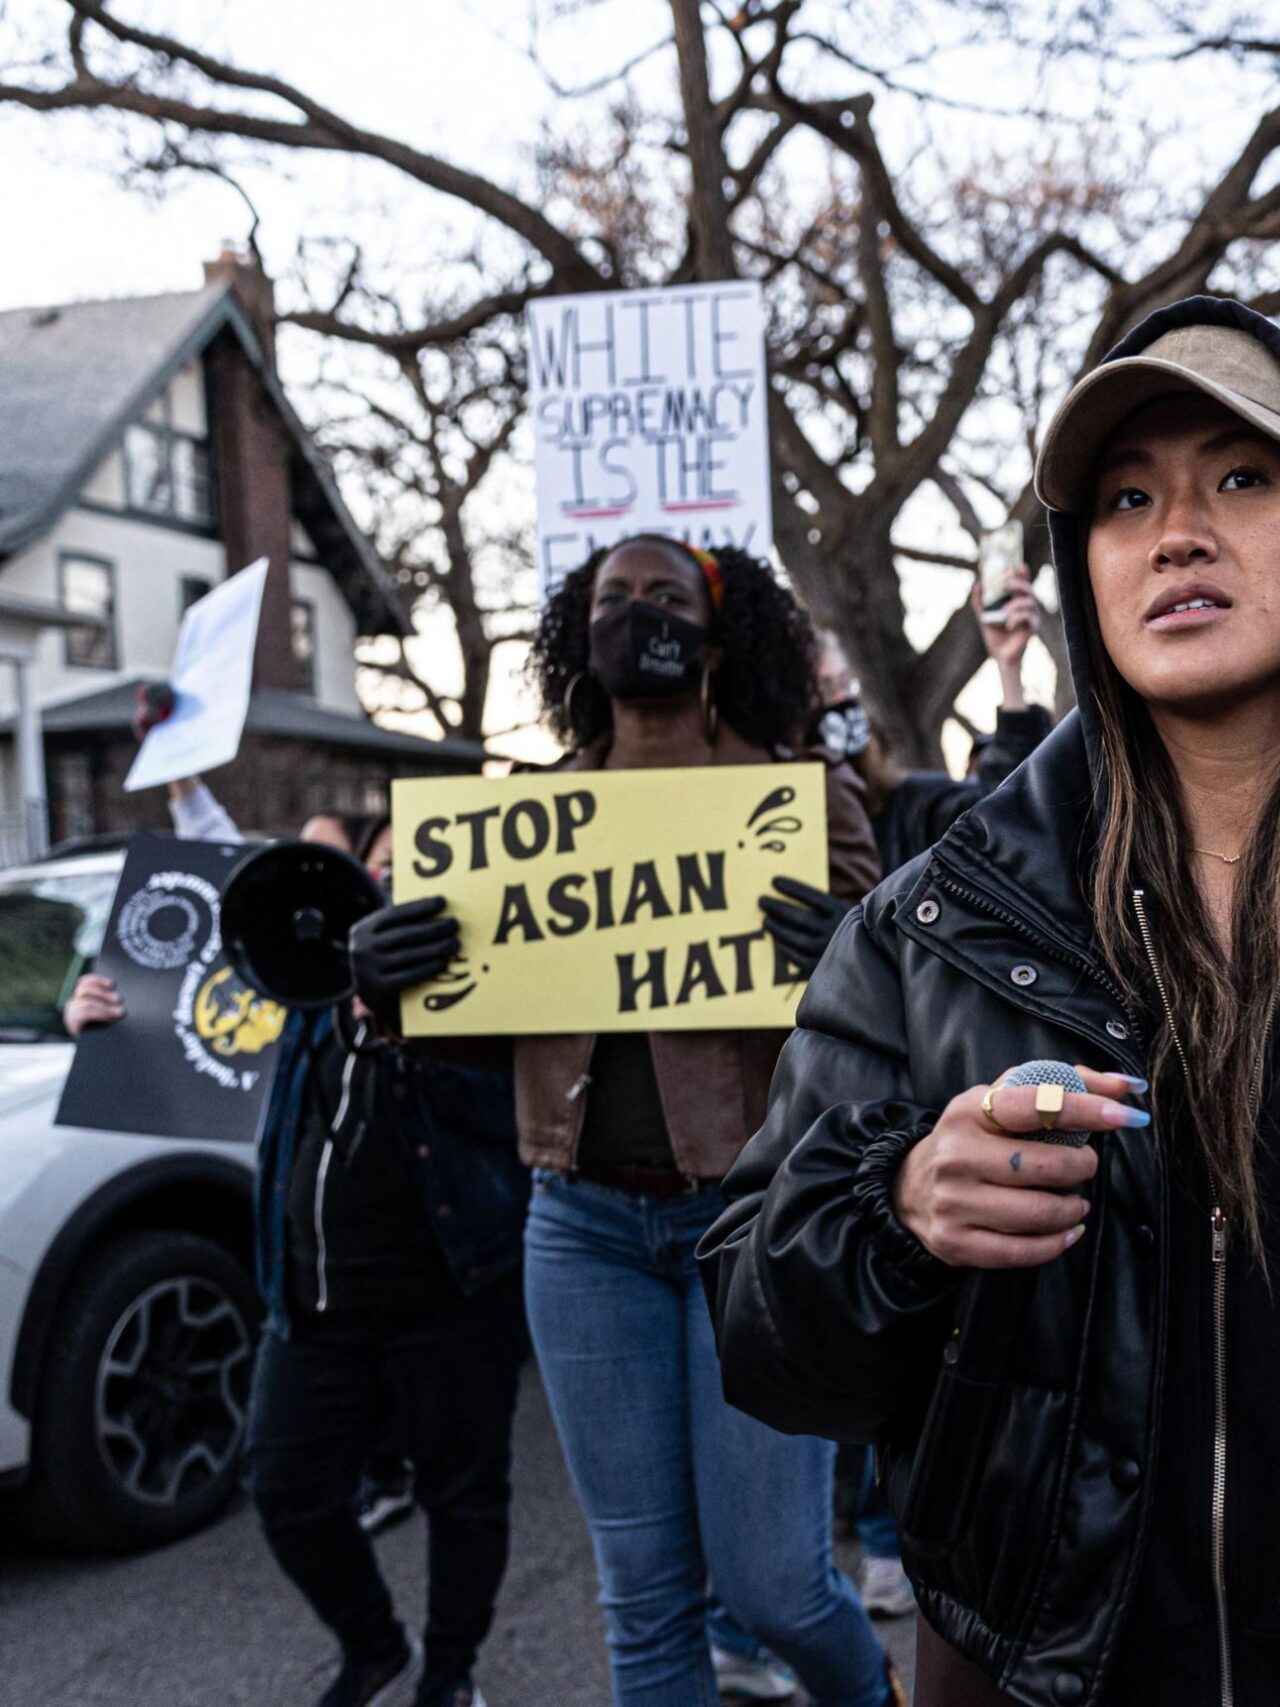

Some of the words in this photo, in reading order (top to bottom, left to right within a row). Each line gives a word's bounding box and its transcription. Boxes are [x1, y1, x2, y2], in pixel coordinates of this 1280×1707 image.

[526, 290, 756, 389] WHITE
[536, 383, 755, 443] SUPREMACY
[559, 435, 638, 511] IS
[646, 430, 738, 503] THE
[412, 789, 596, 879] STOP
[492, 850, 729, 945] ASIAN
